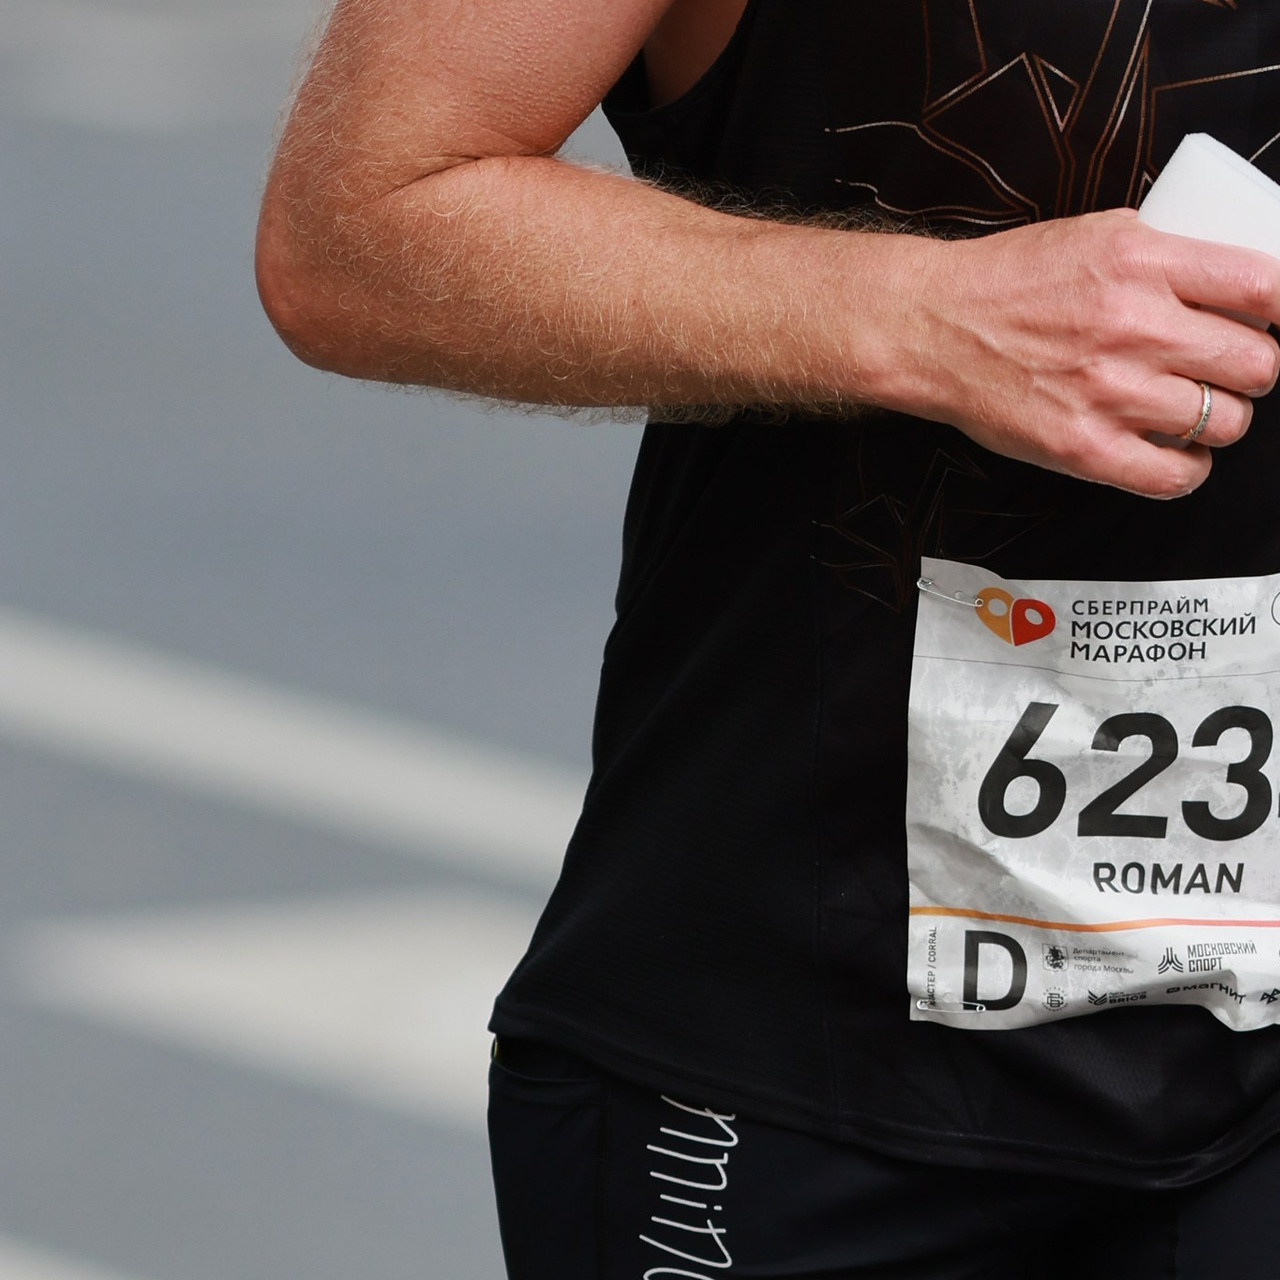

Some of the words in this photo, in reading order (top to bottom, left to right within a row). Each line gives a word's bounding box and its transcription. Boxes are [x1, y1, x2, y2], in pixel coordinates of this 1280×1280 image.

[1071, 595, 1209, 615] СБЕРПРАЙМ
[1071, 612, 1256, 640] МОСКОВСКИЙ
[1070, 641, 1206, 663] МАРАФОН
[1093, 862, 1245, 895] ROMAN
[928, 926, 937, 963] CORRAL
[1187, 940, 1257, 959] МОСКОВСКИЙ
[962, 929, 1028, 1011] D
[1074, 963, 1101, 972] города
[1103, 964, 1134, 974] Москвы
[1188, 956, 1223, 973] СПОРТ
